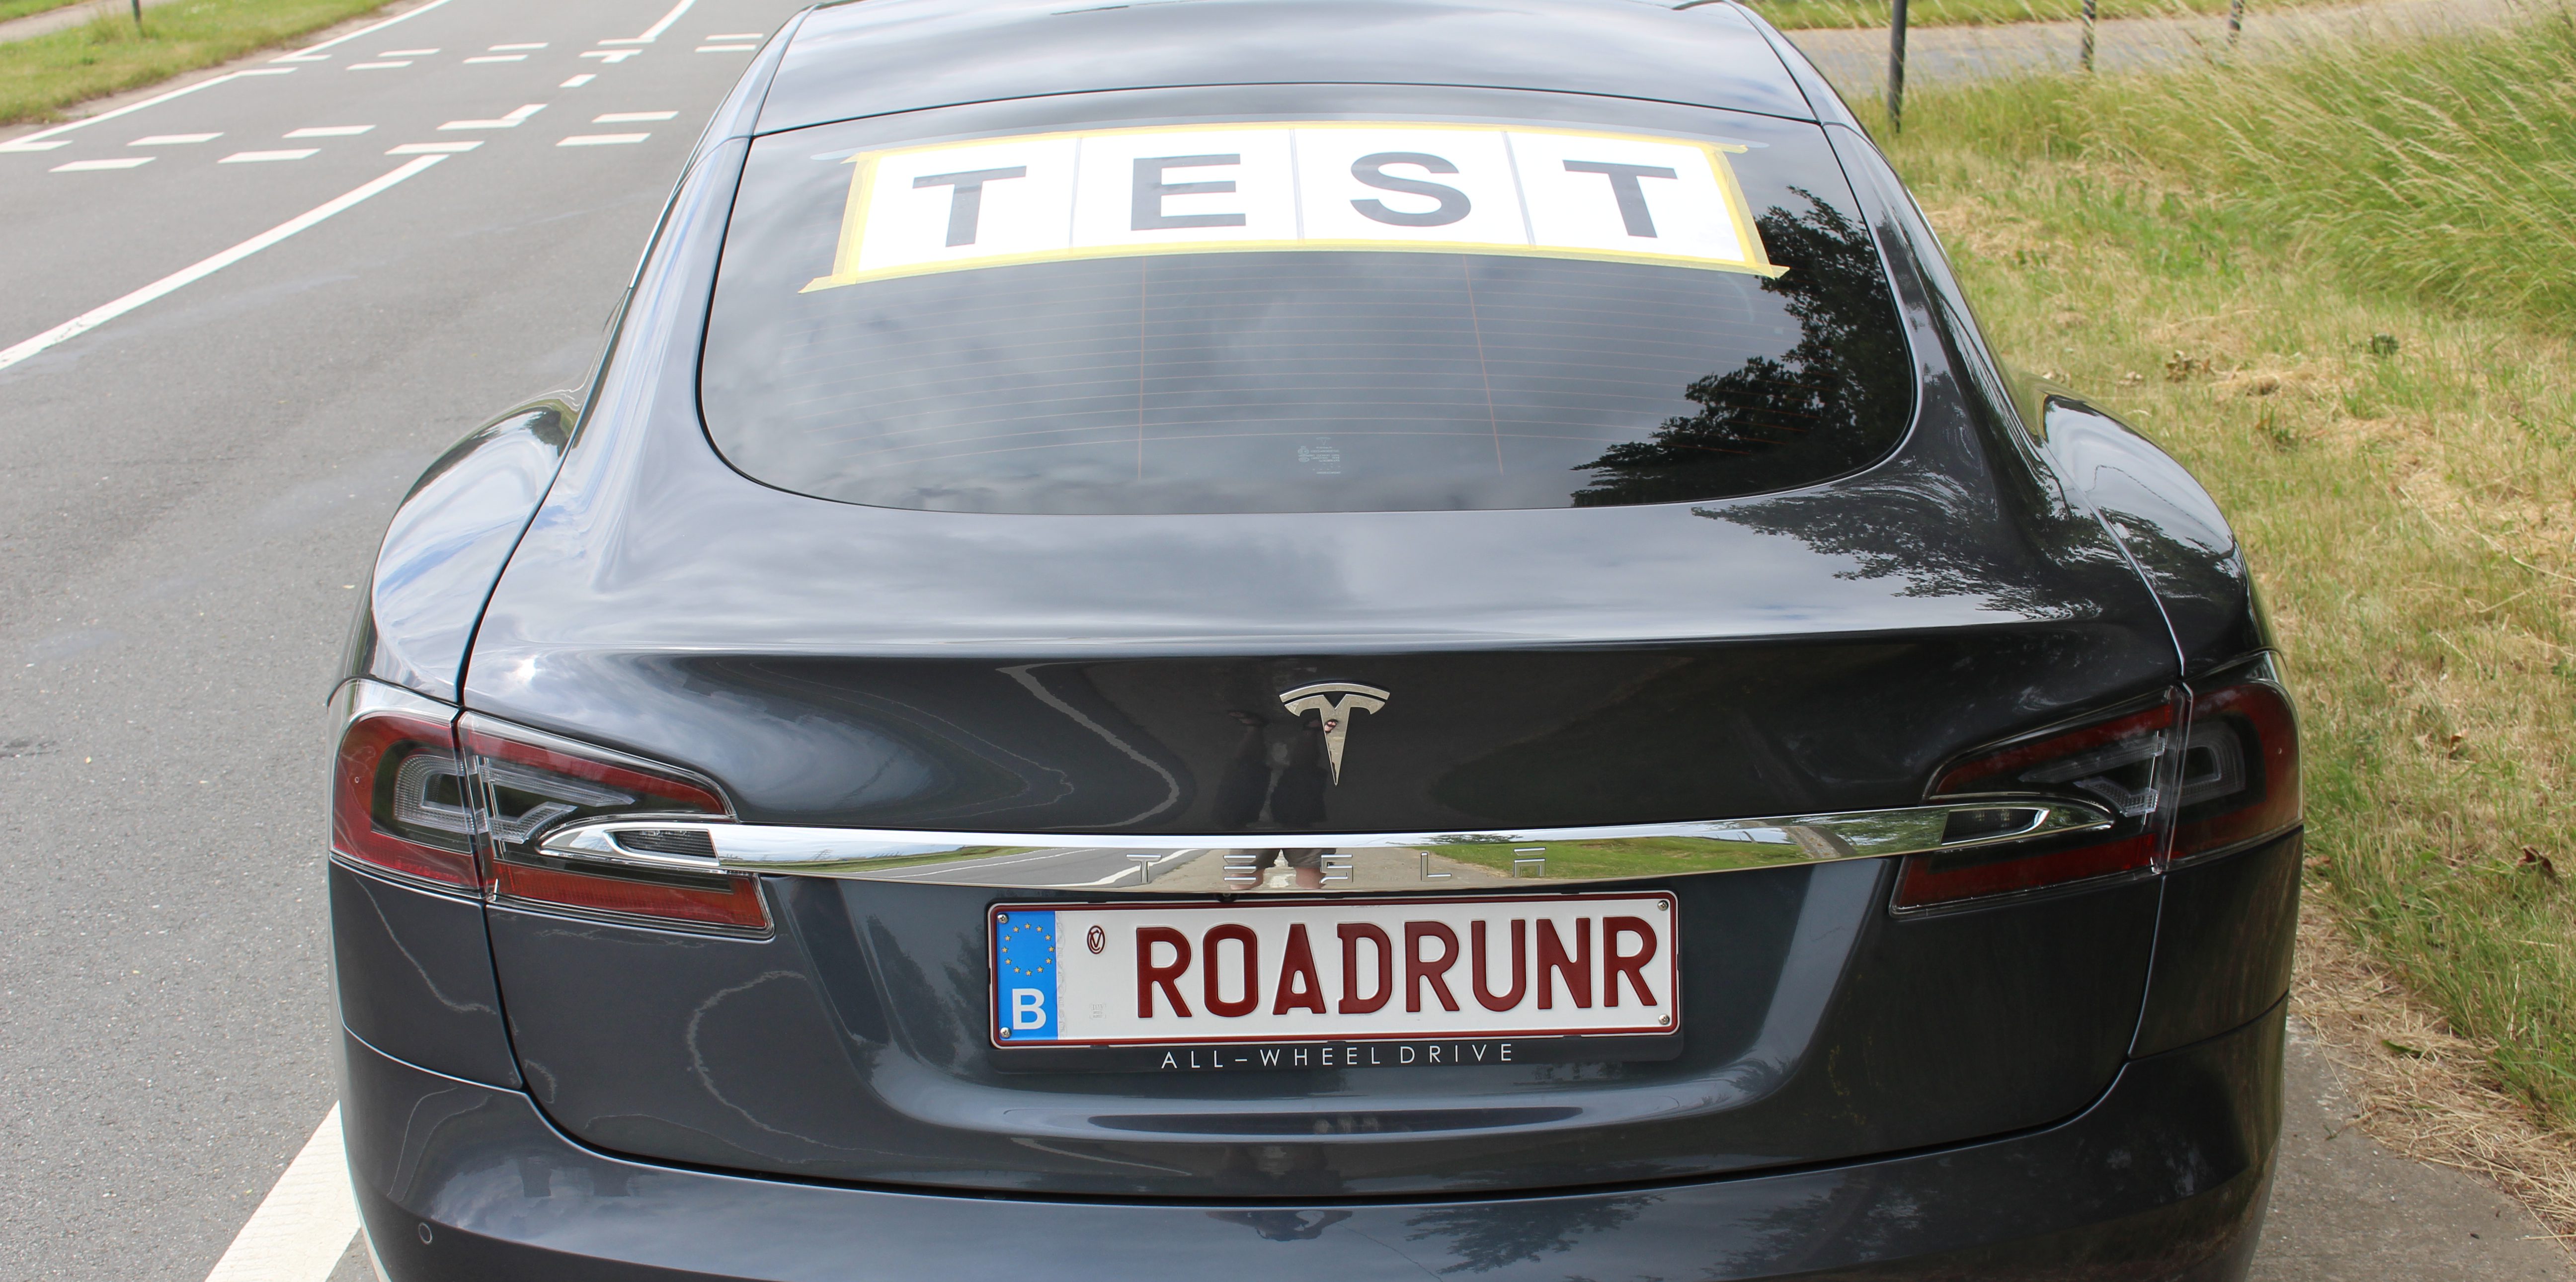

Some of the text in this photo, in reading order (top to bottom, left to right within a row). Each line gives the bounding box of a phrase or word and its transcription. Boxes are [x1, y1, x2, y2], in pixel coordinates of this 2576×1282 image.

[912, 151, 1678, 248] TEST
[1126, 846, 1547, 884] TESLA
[1136, 916, 1658, 1019] ROADRUNR
[1012, 988, 1046, 1030] B
[1400, 1043, 1512, 1063] DRIVE
